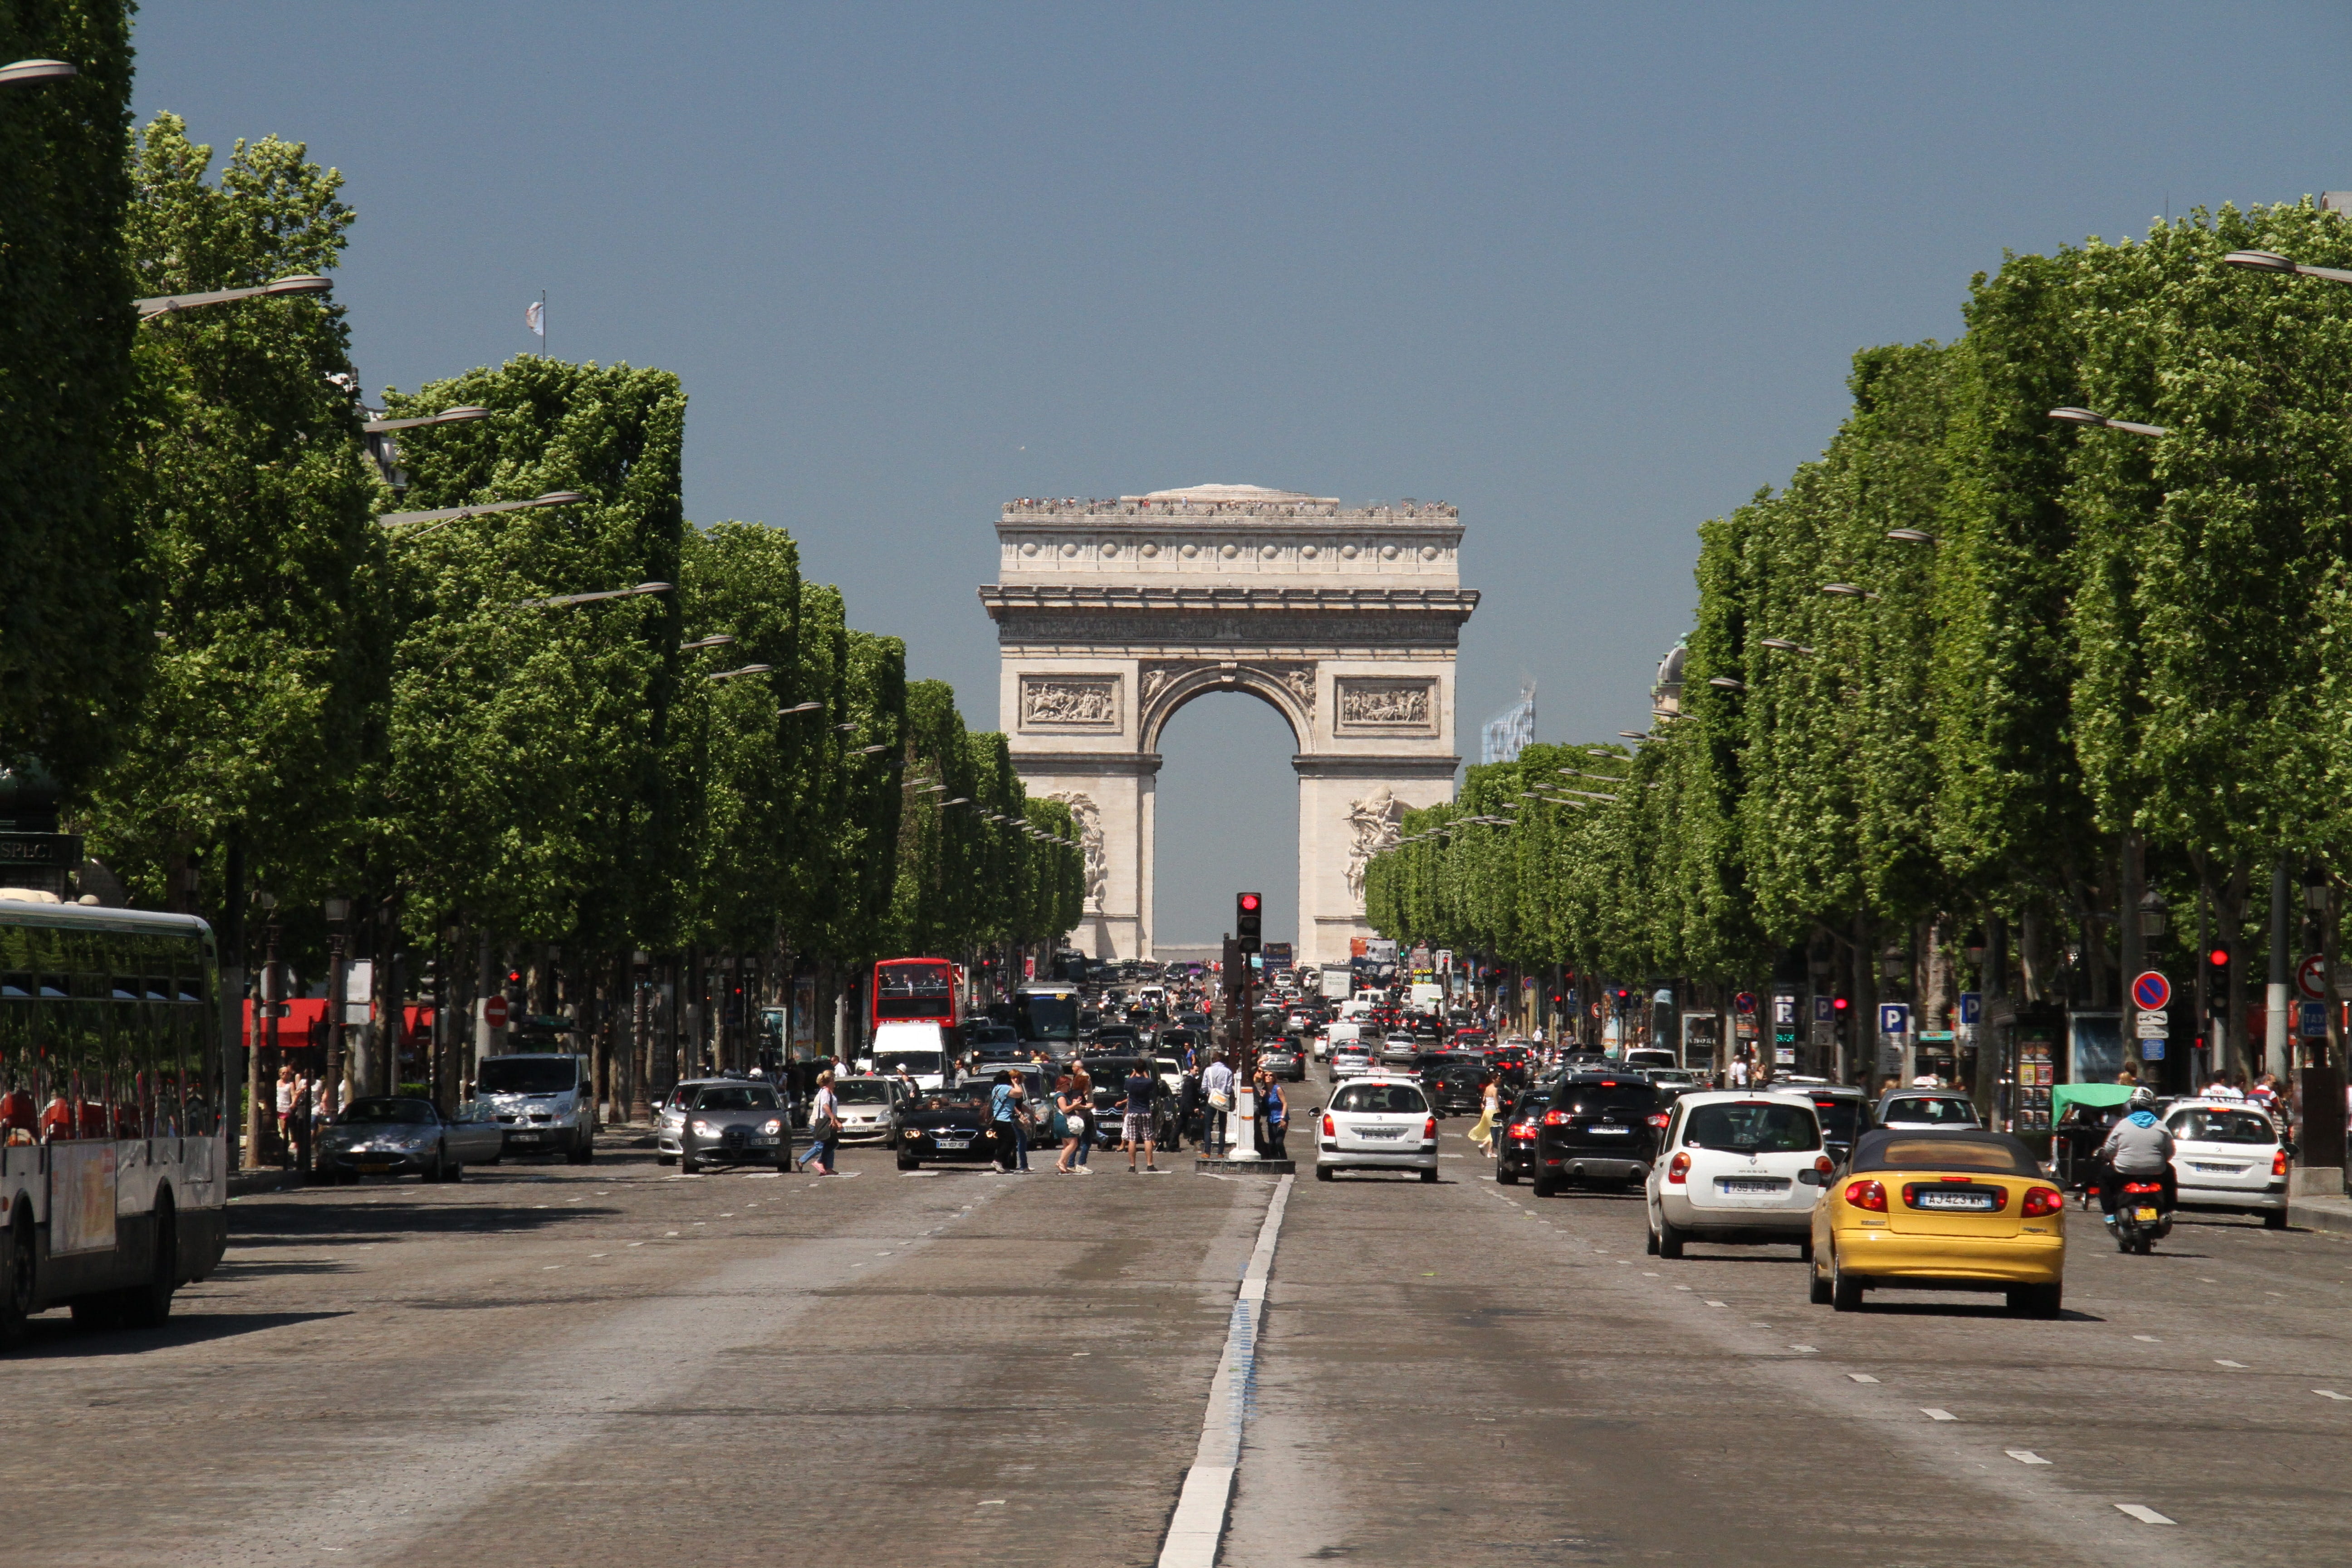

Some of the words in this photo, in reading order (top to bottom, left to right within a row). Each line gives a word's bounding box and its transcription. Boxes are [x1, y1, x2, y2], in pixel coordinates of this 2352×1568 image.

[1818, 1000, 1829, 1017] P
[1967, 999, 1979, 1019] P
[1886, 1010, 1901, 1029] P
[1732, 1183, 1748, 1192] 739
[1751, 1183, 1763, 1192] ZP
[1929, 1193, 1944, 1204] AJ
[1945, 1194, 1967, 1205] 423
